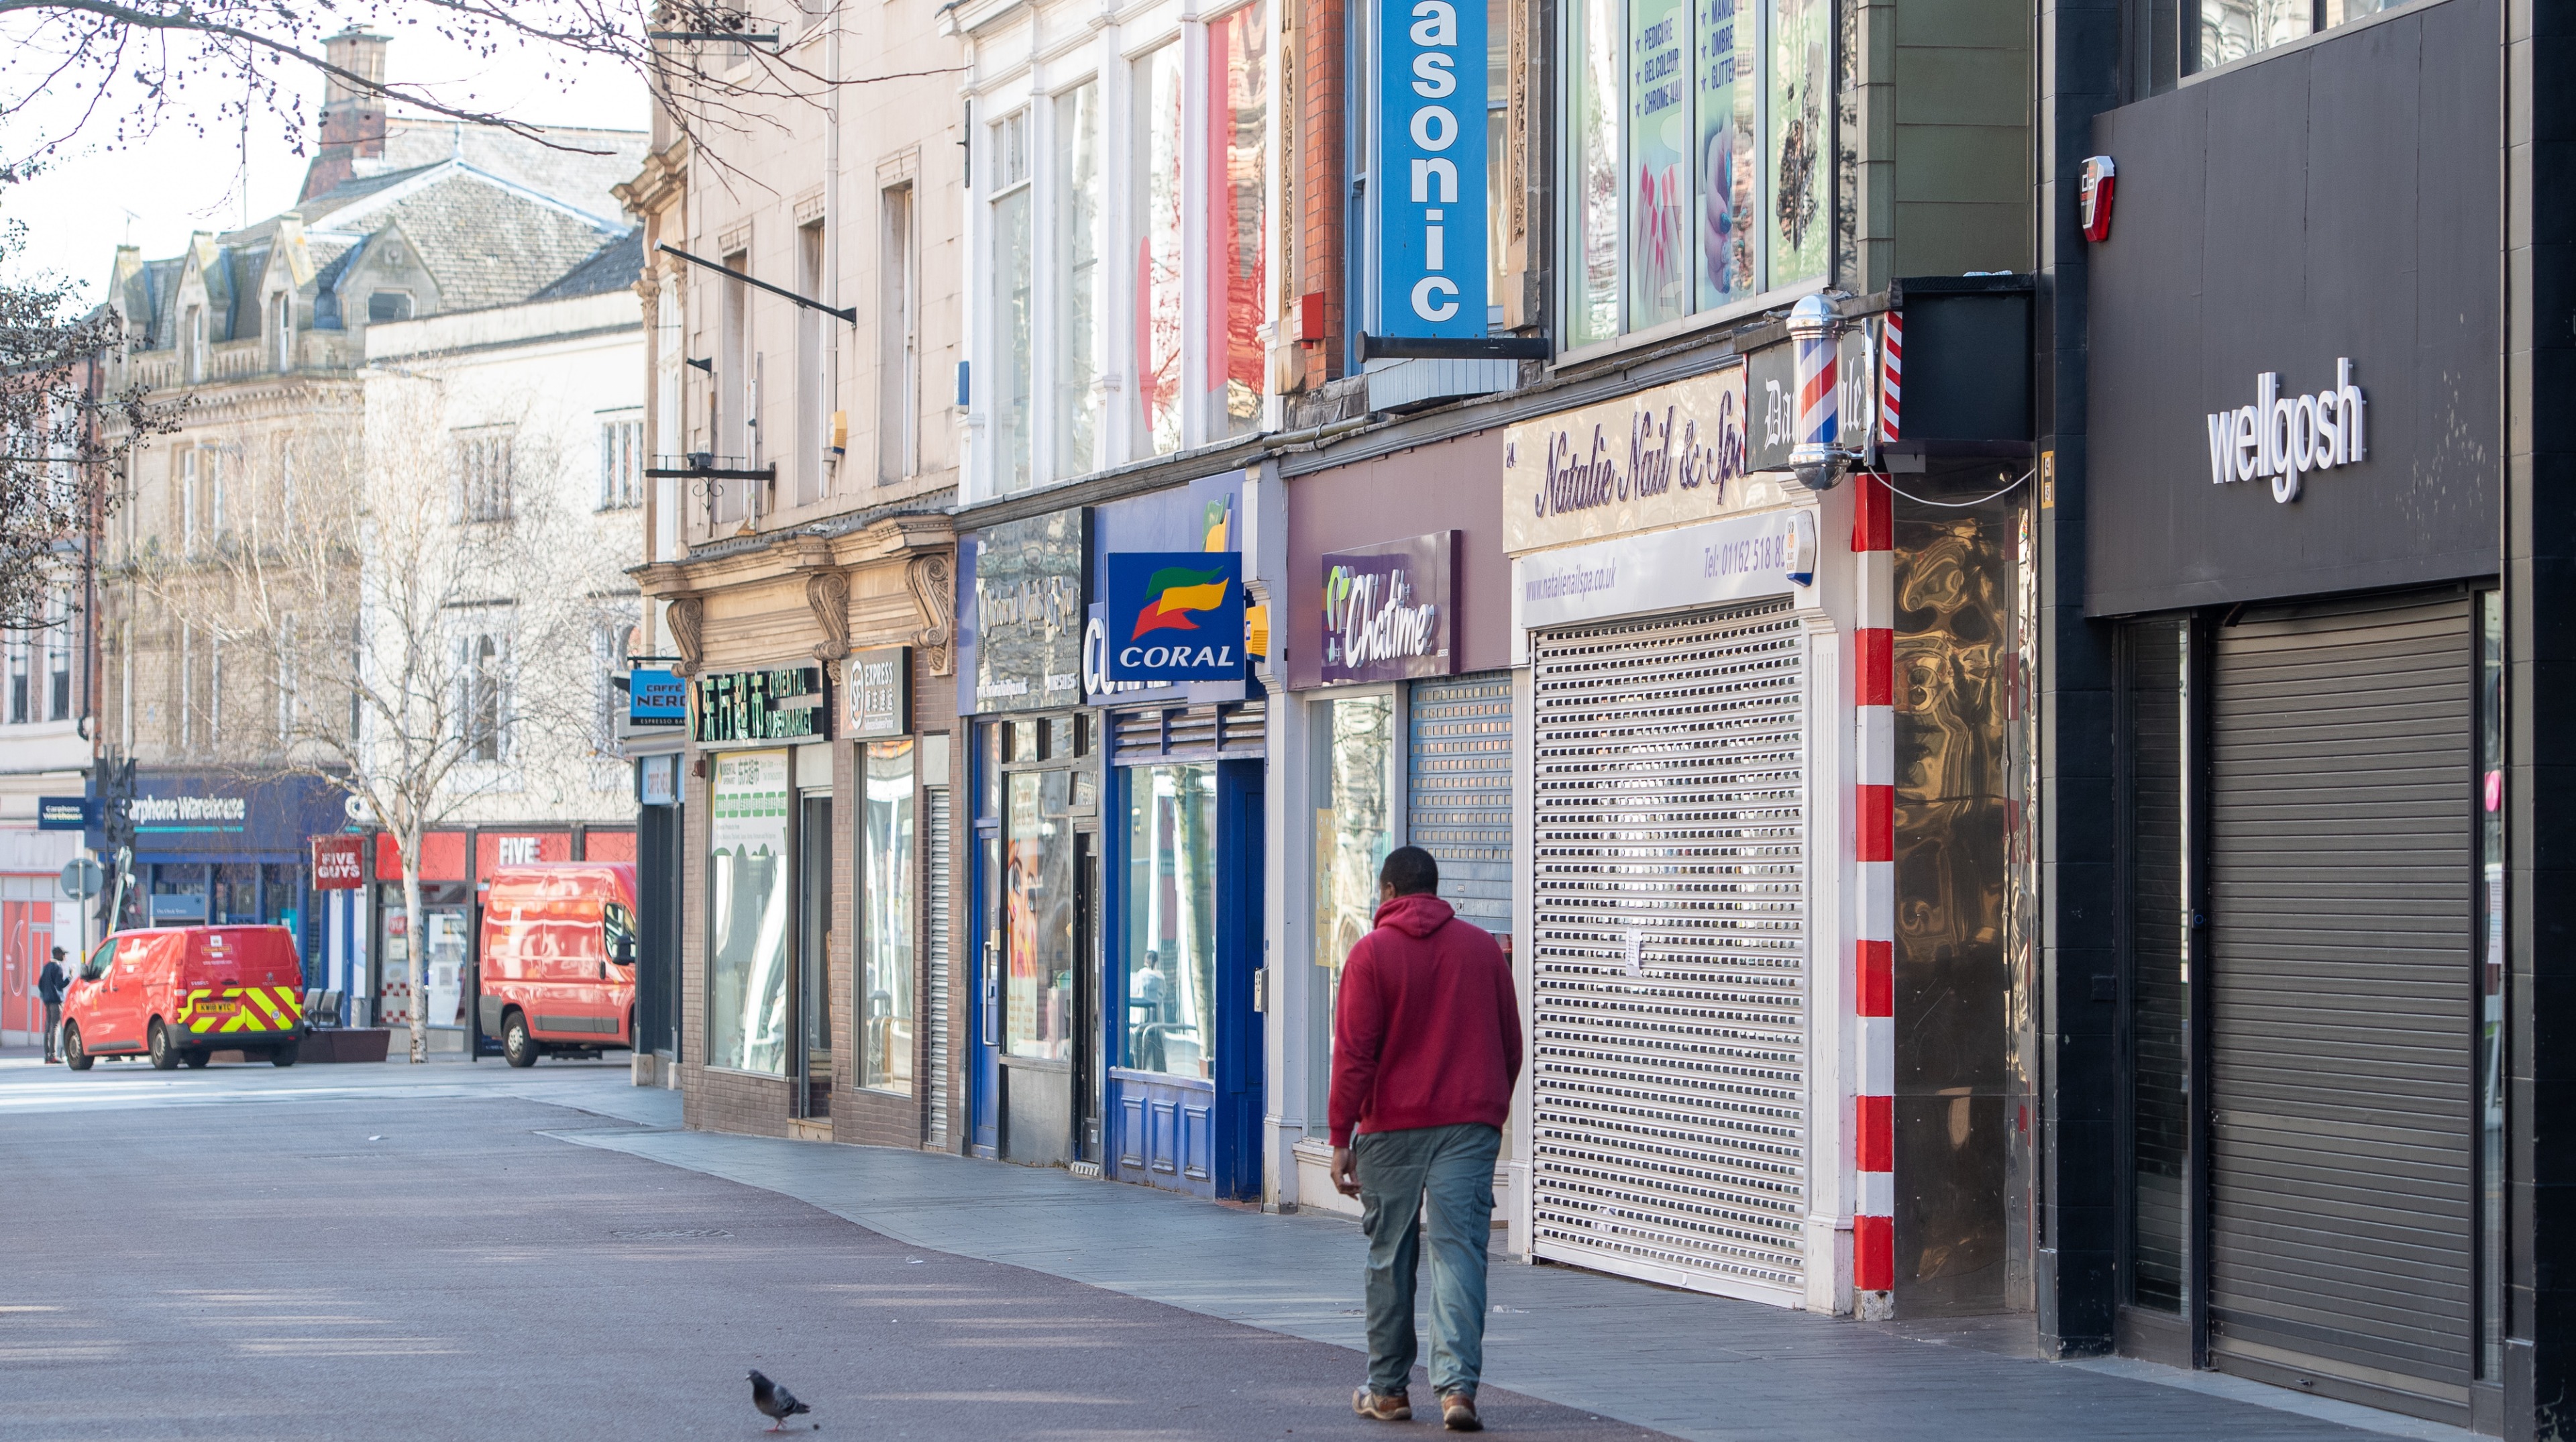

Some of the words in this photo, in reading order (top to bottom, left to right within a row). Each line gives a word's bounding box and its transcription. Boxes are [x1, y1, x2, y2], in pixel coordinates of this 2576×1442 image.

[1645, 17, 1673, 52] PEDICURE
[1712, 24, 1733, 58] OMBRE
[1645, 58, 1656, 84] GEL
[1656, 48, 1679, 79] COLOUR
[1645, 85, 1669, 115] CHROME
[2207, 357, 2363, 503] wellgosh
[1536, 423, 1615, 517] Natalie
[1618, 405, 1676, 501] Nail
[1679, 419, 1703, 490] &
[1705, 548, 1719, 578] Tel:
[1721, 538, 1750, 576] 01162
[1754, 535, 1772, 570] 518
[1525, 558, 1617, 602] www.natalienailspa.co.uk
[1344, 569, 1434, 669] Chatime
[1120, 646, 1234, 668] CORAL
[769, 668, 807, 700] ORIENTAL
[865, 661, 894, 686] EXPRESS
[765, 707, 812, 738] SUPERMARKET
[42, 812, 83, 821] Warehouse
[45, 805, 80, 814] Carphone
[177, 792, 246, 821] Warehouse
[321, 852, 356, 864] FIVE
[499, 837, 541, 865] FIVE
[317, 864, 360, 878] GUYS
